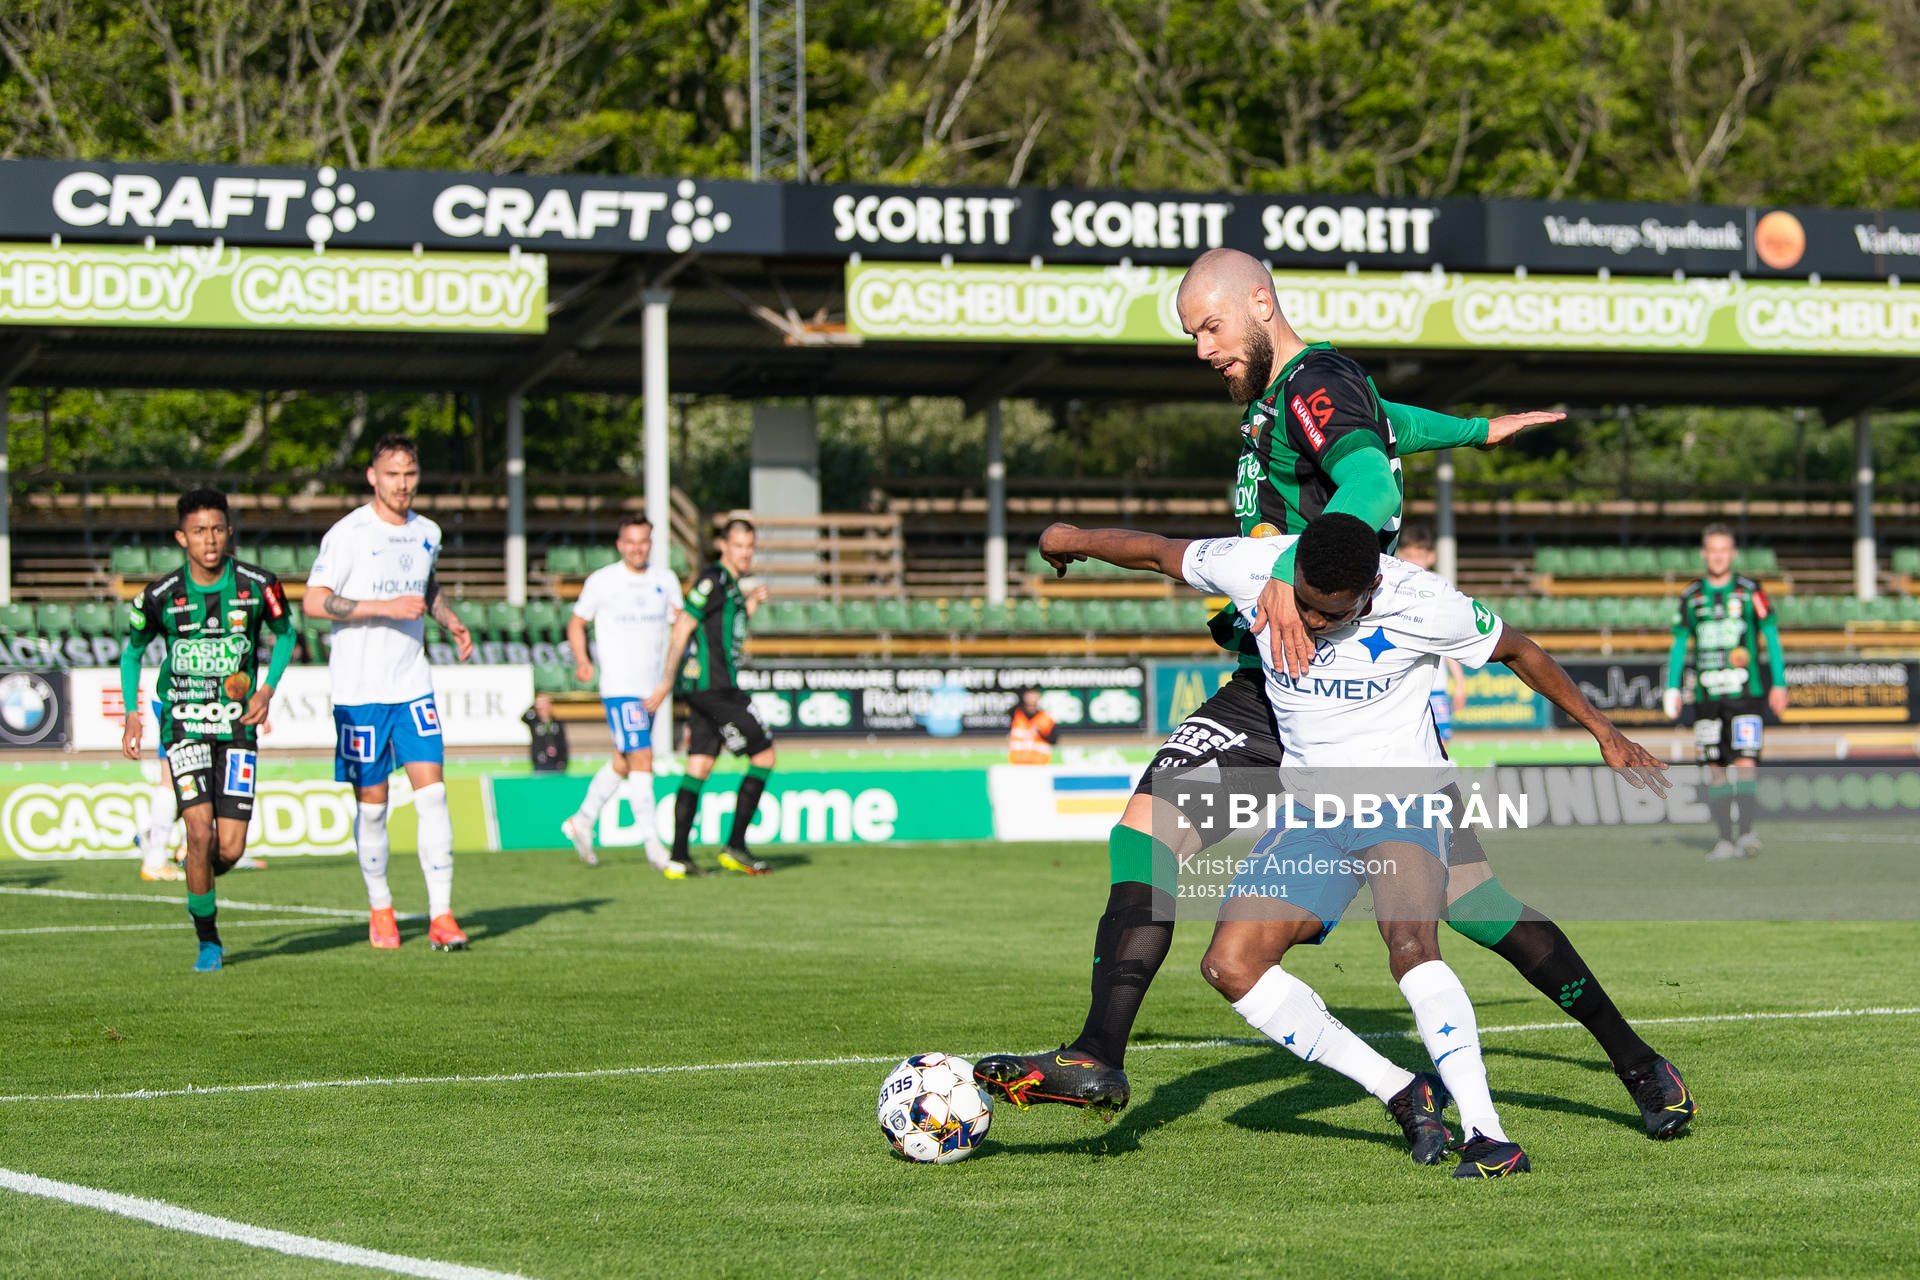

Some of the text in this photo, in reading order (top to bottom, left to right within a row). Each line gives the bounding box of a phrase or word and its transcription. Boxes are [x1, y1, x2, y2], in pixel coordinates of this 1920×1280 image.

[52, 171, 307, 231] CRAFT
[432, 184, 668, 241] CRAFT
[832, 194, 1013, 245] SCORETT
[1050, 199, 1227, 249] SCORETT
[1262, 204, 1434, 254] SCORETT
[243, 266, 530, 315] CASHBUDDY
[860, 280, 1122, 328] CASHBUDDY
[1281, 290, 1418, 329] BUDDY
[1464, 294, 1700, 334] CASHBUDDY
[1292, 397, 1325, 449] KVANTUM
[176, 655, 240, 674] BUDDY
[177, 641, 226, 658] CASH
[1497, 767, 1737, 826] UNIBE
[879, 1074, 913, 1108] SELEC
